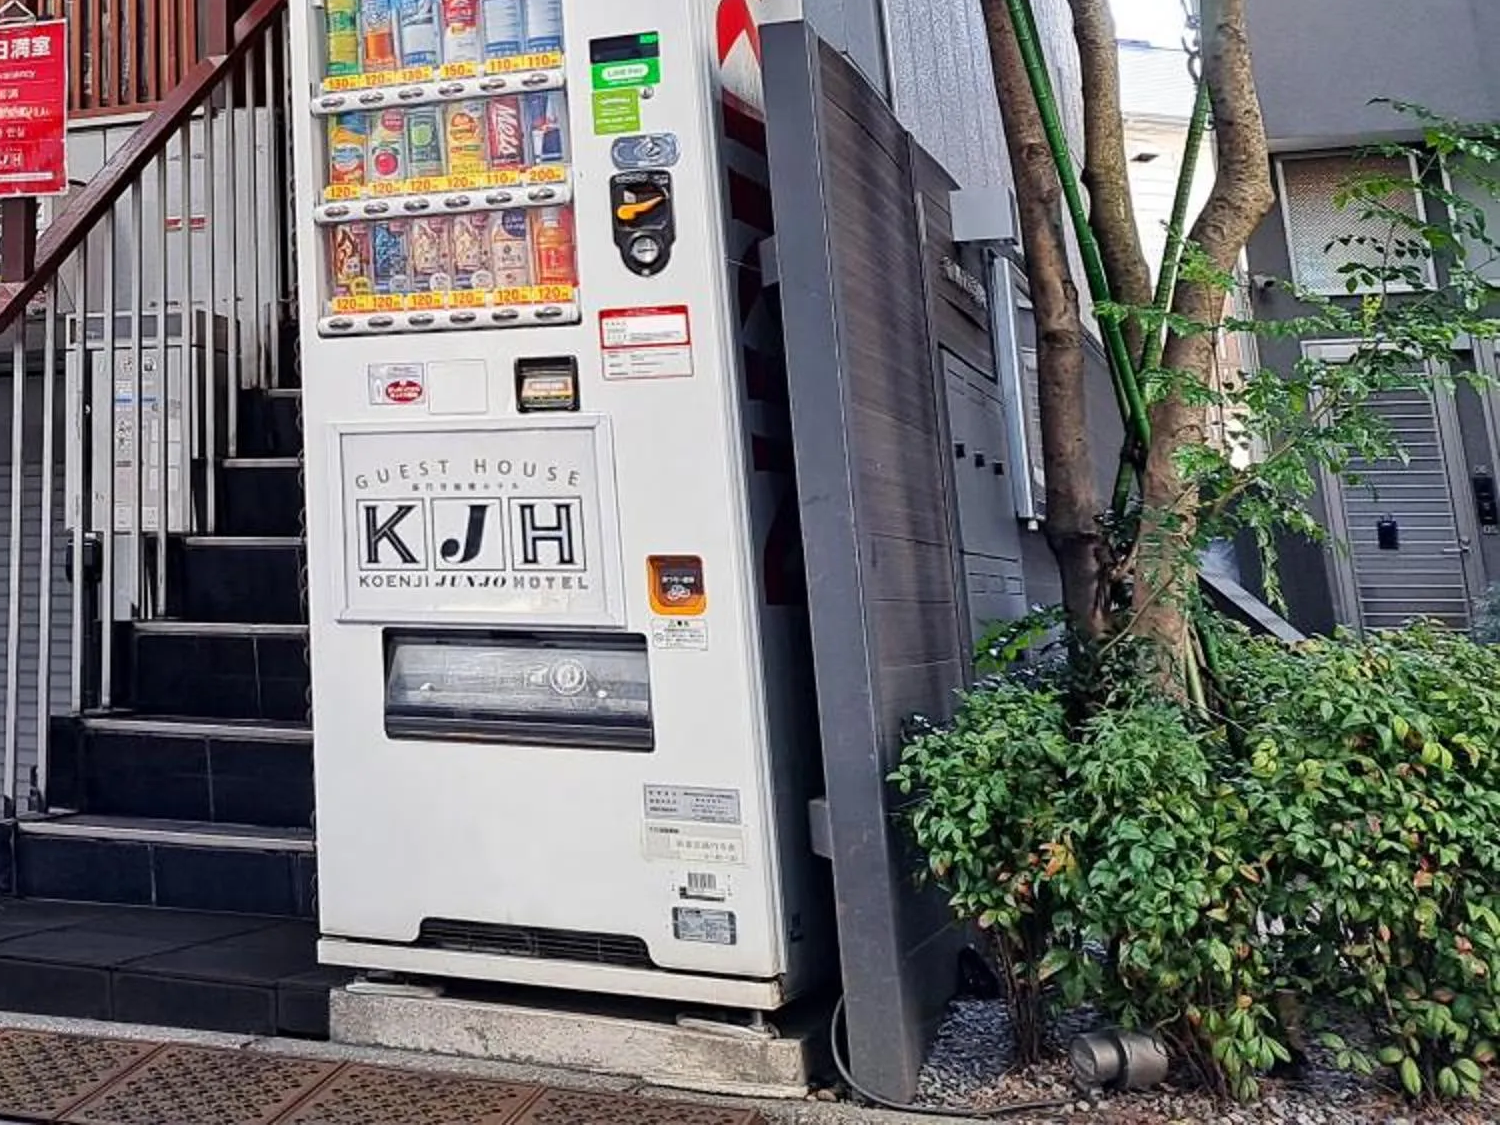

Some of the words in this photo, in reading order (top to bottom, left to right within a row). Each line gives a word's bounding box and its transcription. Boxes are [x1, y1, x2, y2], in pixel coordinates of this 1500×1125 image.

[354, 459, 450, 491] GUEST
[473, 458, 581, 488] HOUSE
[358, 574, 430, 589] KOENJI
[434, 575, 507, 589] JUNJO
[513, 575, 590, 591] HOTEL
